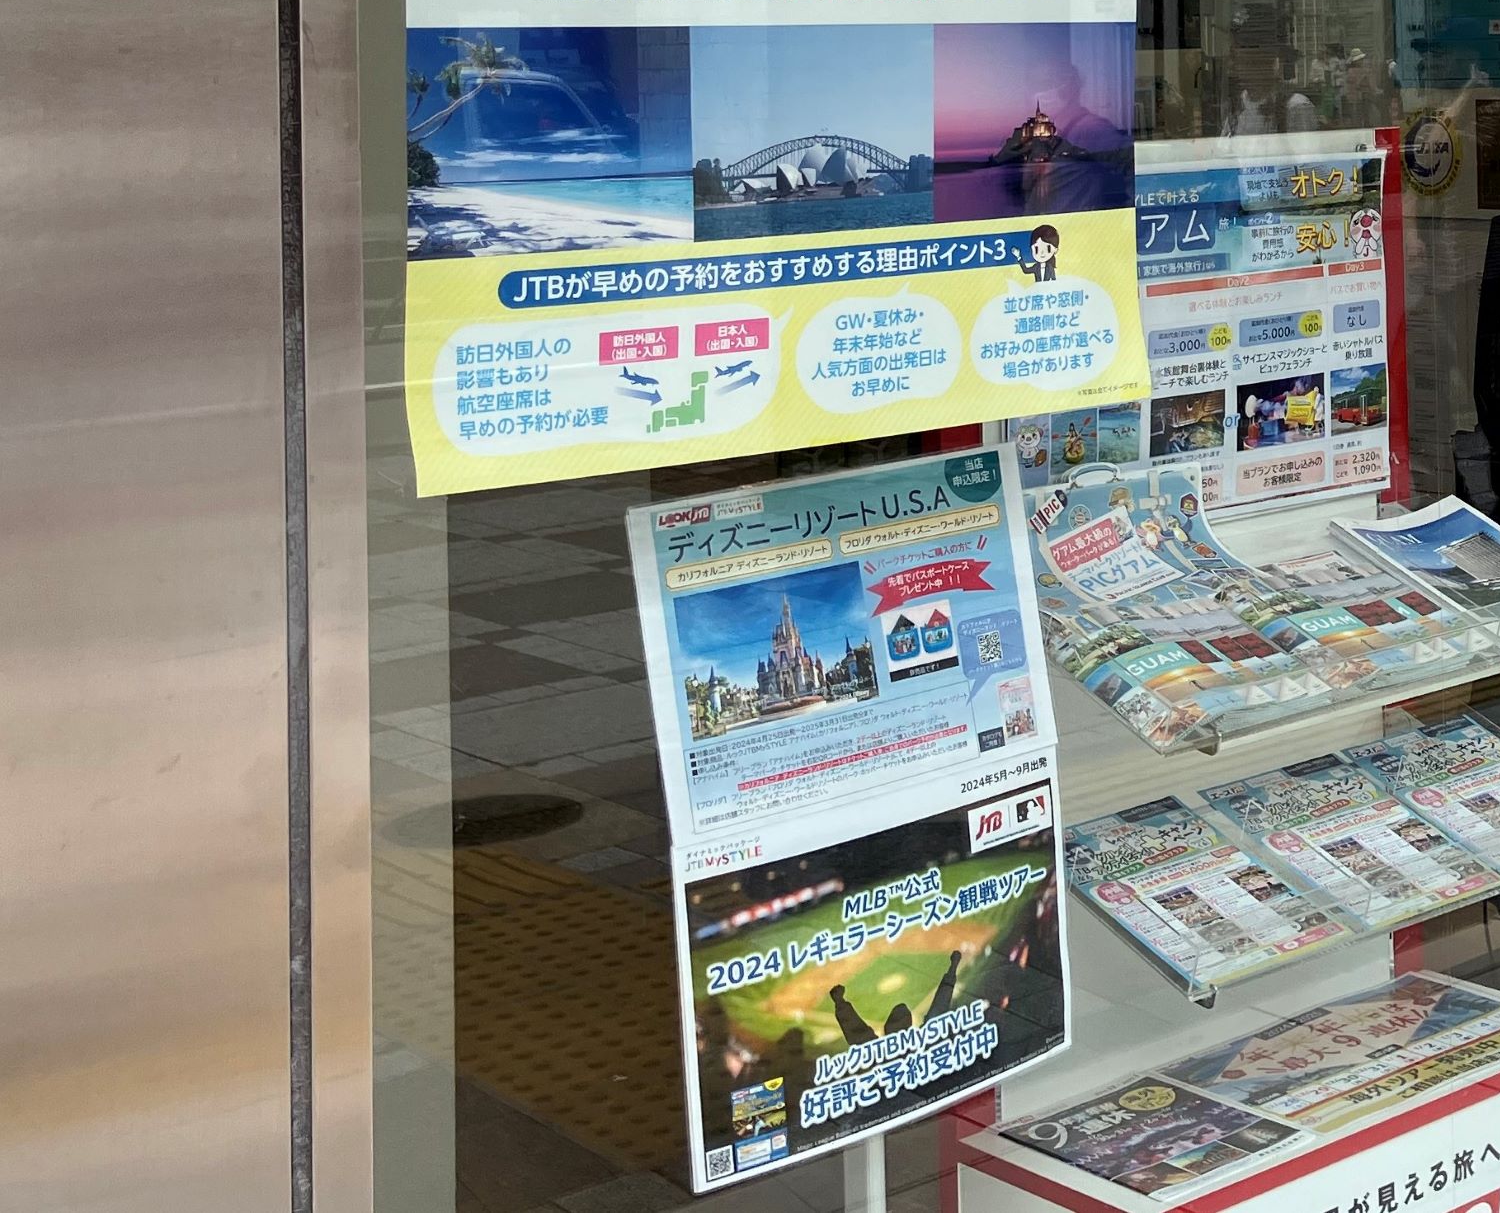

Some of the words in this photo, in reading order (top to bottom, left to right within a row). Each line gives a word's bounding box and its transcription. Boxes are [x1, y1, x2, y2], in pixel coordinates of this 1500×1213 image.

[512, 238, 1007, 303] JTBが早めの予約をおすすめする理由ポイント3
[717, 324, 748, 338] 日本人
[1014, 311, 1081, 335] 通路側など
[1346, 314, 1367, 328] なし
[613, 331, 666, 347] 訪日外国人
[833, 328, 922, 355] 年末年始など
[980, 328, 1115, 360] お好みの座席が選べる
[1332, 335, 1384, 351] 赤いシャトルバス
[456, 337, 572, 366] 訪日外国人の
[1242, 344, 1328, 364] サイエンスマジックショーと
[1345, 347, 1373, 361] 乗り放題
[811, 348, 947, 381] 人気方面の出発日は
[1002, 352, 1095, 380] 場合があります
[1259, 359, 1313, 374] ビュッフェランチ
[456, 364, 550, 392] 影響もあり
[851, 376, 910, 398] お早めに
[1153, 371, 1229, 390] ーチで楽しむランチ
[457, 388, 552, 417] 航空座席は
[459, 406, 609, 442] 早めの予約が必要
[1224, 413, 1240, 428] or
[964, 458, 984, 471] 当店
[1242, 456, 1323, 480] 当プランでお申し込みの
[1263, 472, 1302, 488] お客様限定
[658, 509, 692, 528] LOOK
[1044, 498, 1061, 520] PIC
[845, 534, 872, 549] フロリダ
[877, 541, 972, 569] パークチケットご購入の方に
[677, 563, 734, 582] カリフォルニア
[887, 561, 970, 587] 先着でパスポートケース
[1301, 613, 1356, 633] GUAM
[1126, 648, 1190, 677] GUAM
[975, 809, 1003, 841] JTB
[706, 949, 782, 993] 2024
[788, 867, 1047, 970] レギュラーシーズン観戦ツアー
[814, 1001, 984, 1084] ルックJTBMySTYLE
[802, 1023, 999, 1125] 好評ご予約受付中
